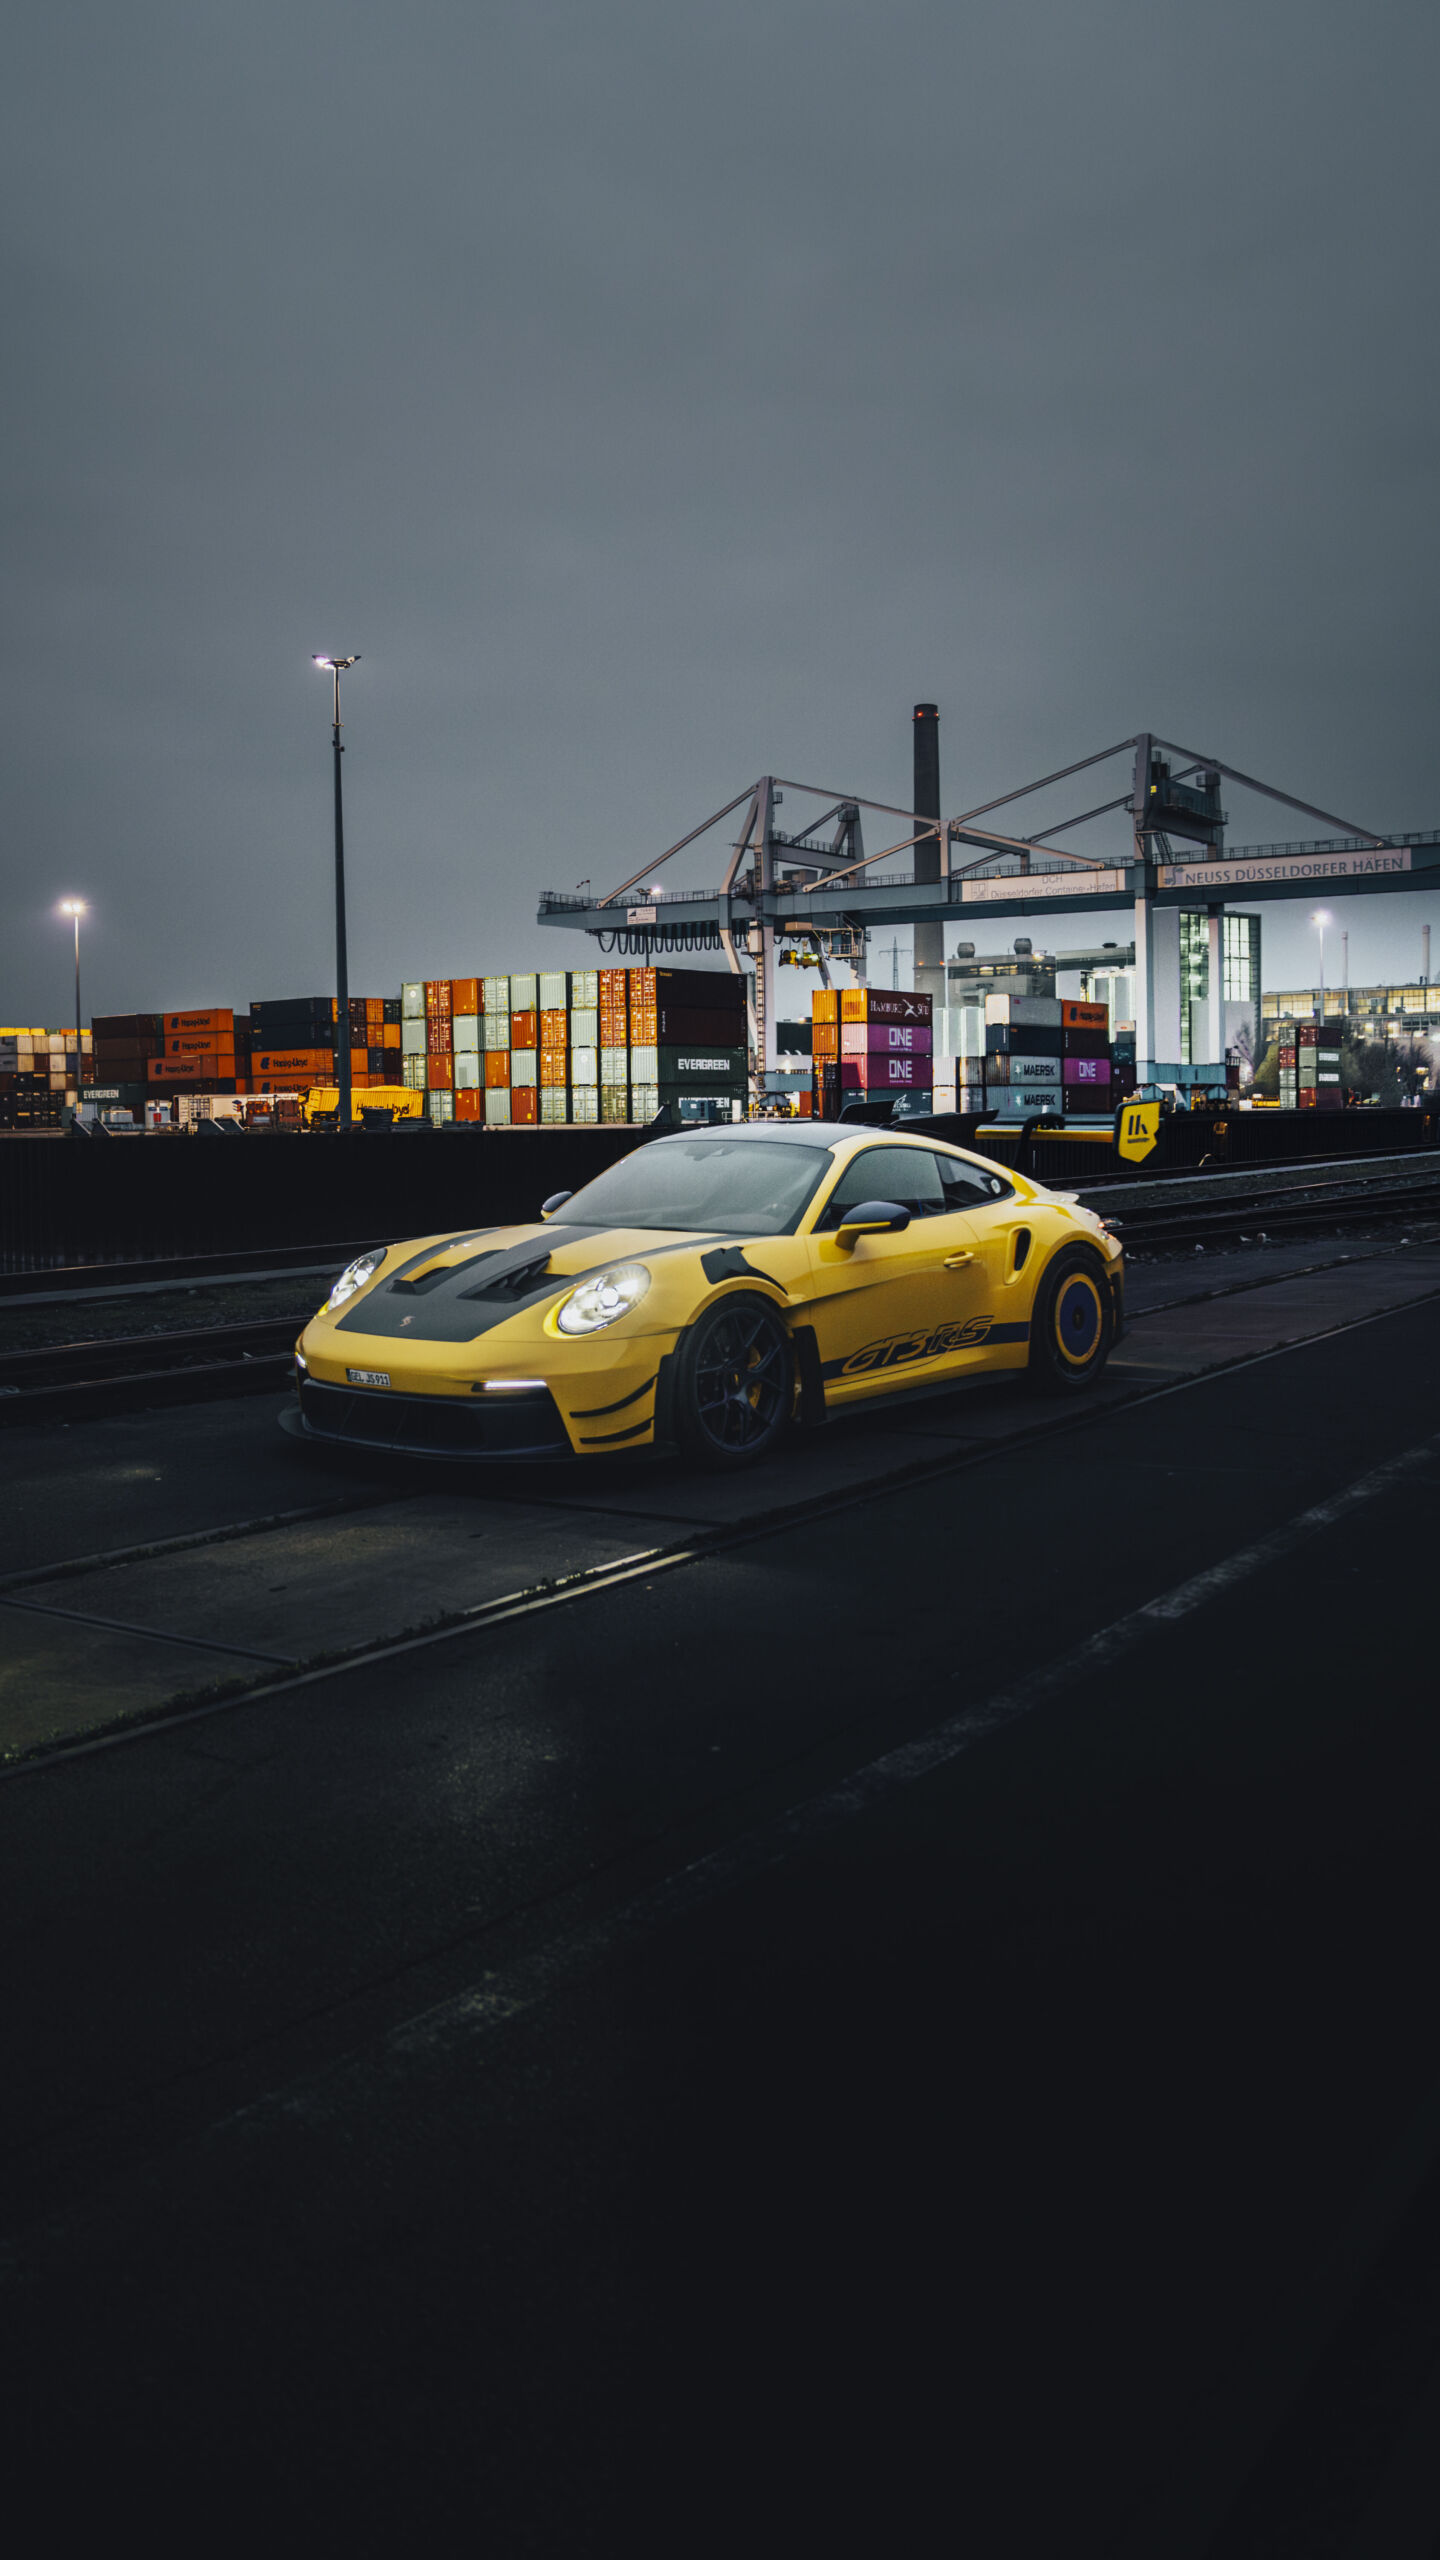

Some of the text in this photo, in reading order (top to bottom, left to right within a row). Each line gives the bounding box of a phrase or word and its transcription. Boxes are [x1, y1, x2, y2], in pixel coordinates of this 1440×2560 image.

[1185, 857, 1403, 885] NEUSS DÜSSELDORFER HÄFEN
[1041, 875, 1063, 885] DCH
[888, 1028, 913, 1047] ONE
[678, 1058, 730, 1071] EVERGREEN
[888, 1060, 913, 1079] ONE
[1023, 1064, 1055, 1077] MAERSK
[1078, 1061, 1097, 1078] ONE
[83, 1089, 119, 1100] EVERGREEN
[1023, 1094, 1056, 1106] MAERSK
